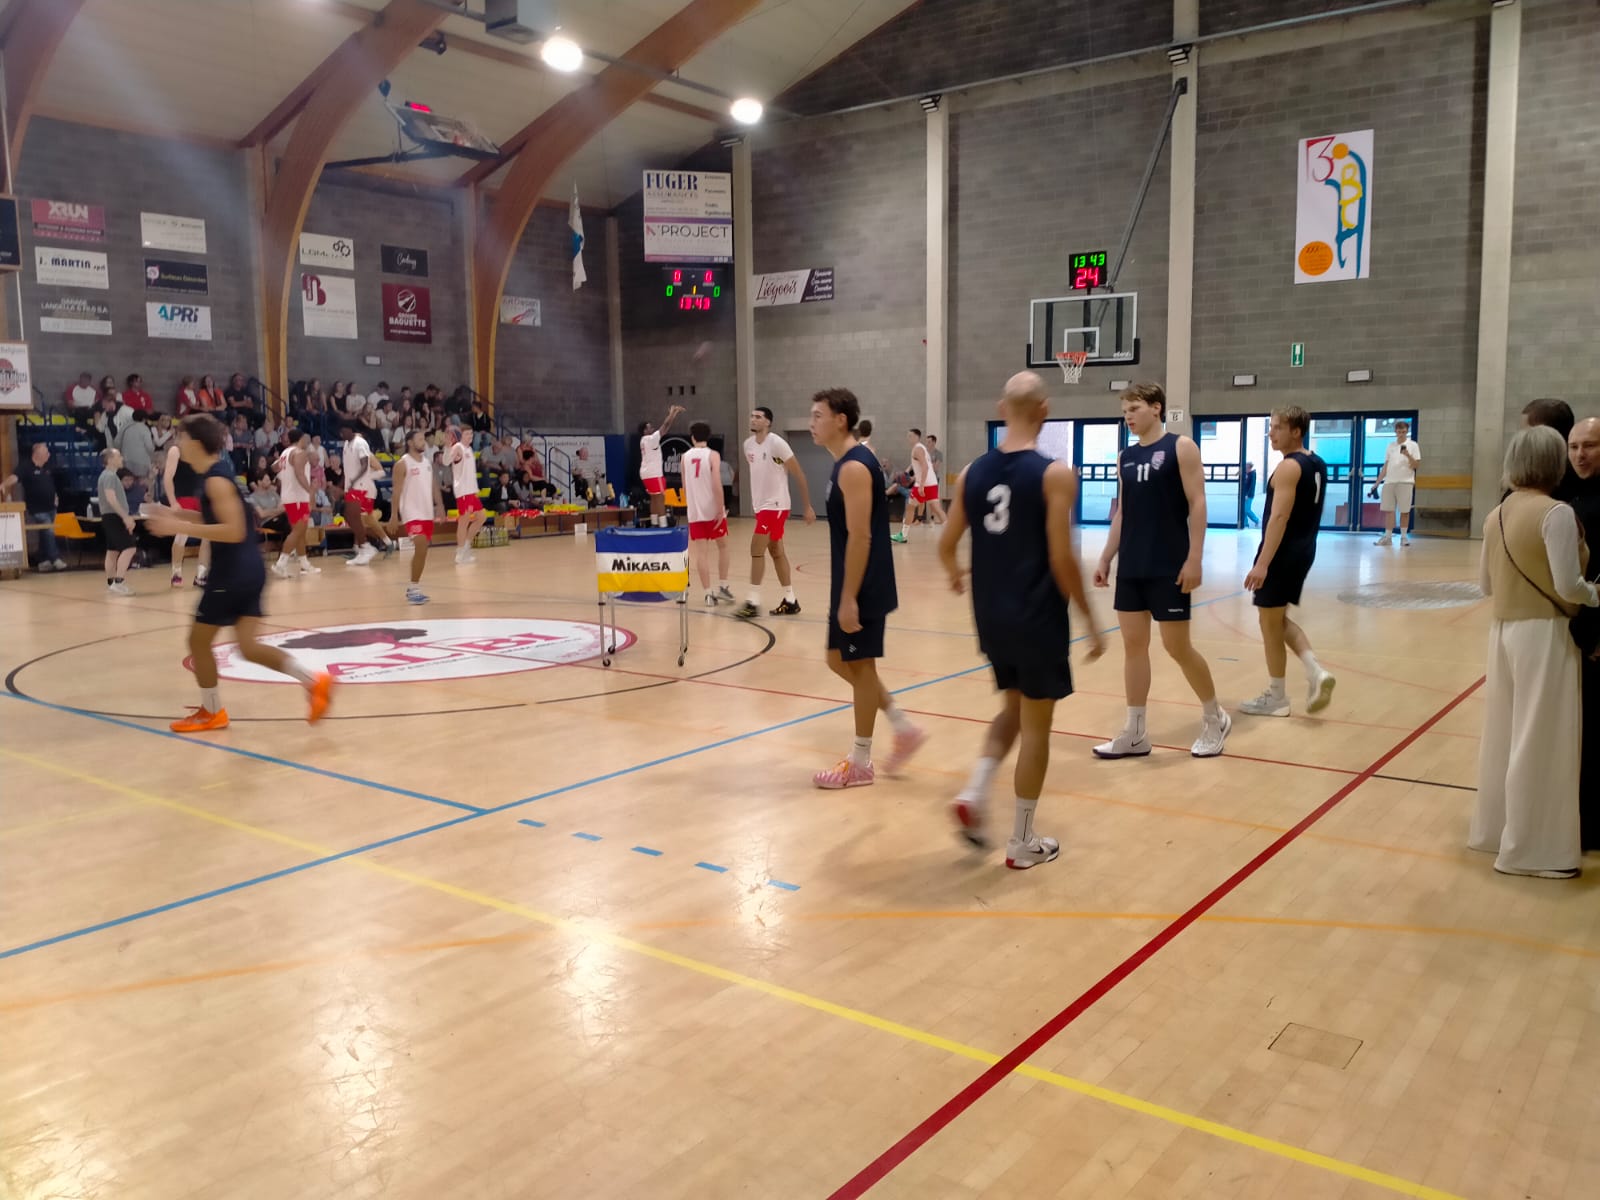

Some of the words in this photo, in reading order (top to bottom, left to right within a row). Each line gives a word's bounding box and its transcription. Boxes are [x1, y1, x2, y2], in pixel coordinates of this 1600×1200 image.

[646, 172, 698, 191] FUGER
[1075, 267, 1099, 288] 24
[666, 285, 673, 297] 0
[713, 285, 721, 297] 0
[691, 458, 702, 478] 7
[1137, 462, 1150, 482] 11
[983, 484, 1012, 534] 3
[611, 557, 670, 571] MIKASA
